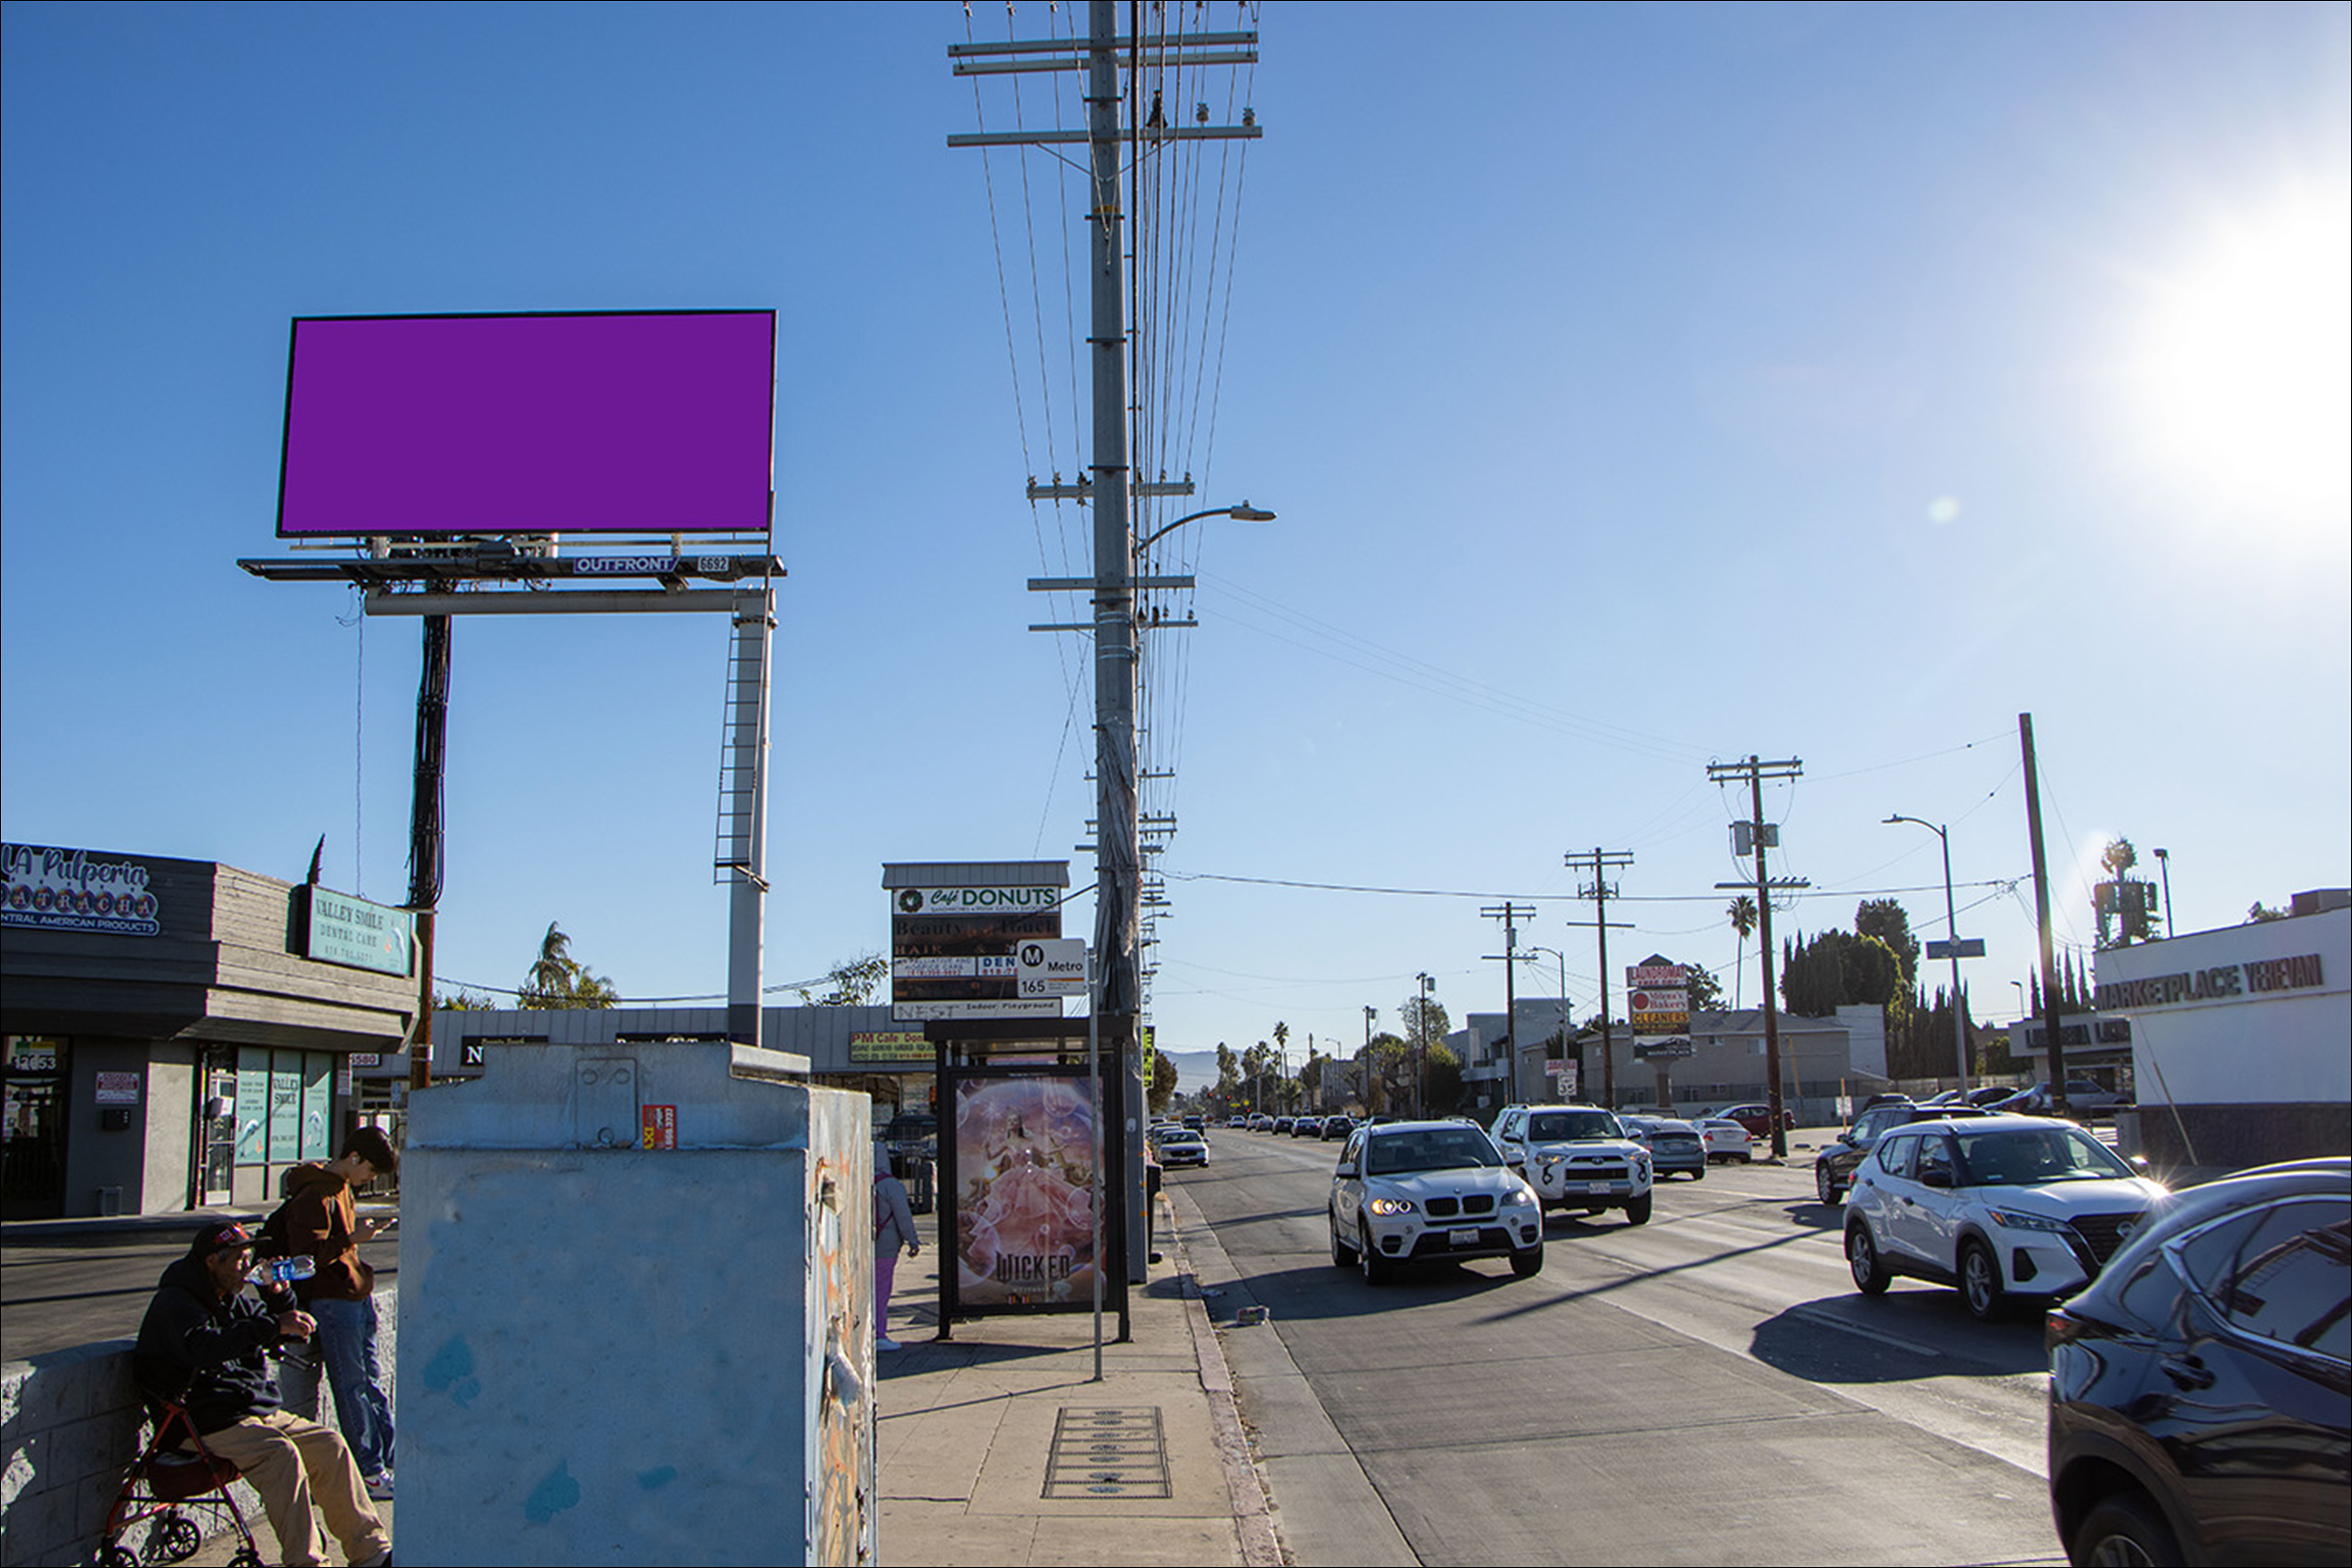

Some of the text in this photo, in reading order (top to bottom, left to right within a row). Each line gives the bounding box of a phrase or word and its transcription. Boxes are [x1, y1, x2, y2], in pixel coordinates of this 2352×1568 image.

[577, 557, 673, 571] OUTFRONT
[699, 557, 727, 570] 6692
[2, 844, 147, 890] LA Pulperia
[1, 885, 152, 916] ATRACHA
[962, 888, 1055, 906] DONUTS
[316, 899, 384, 930] VALLEY SMILE
[40, 915, 95, 928] AMERICAN
[98, 919, 155, 932] PRODUCTS
[896, 921, 964, 938] Beauty
[320, 924, 377, 948] DENTAL CARE
[895, 944, 942, 955] HAIR
[1048, 961, 1084, 972] Metro
[1021, 980, 1046, 994] 165
[2095, 954, 2324, 1011] MARKETPLACE YEREVAN
[1649, 1000, 1687, 1011] Bakery
[1633, 1011, 1689, 1023] CLEANERS
[851, 1033, 874, 1044] PM
[877, 1033, 899, 1044] Cafe
[995, 1250, 1071, 1285] WICKED
